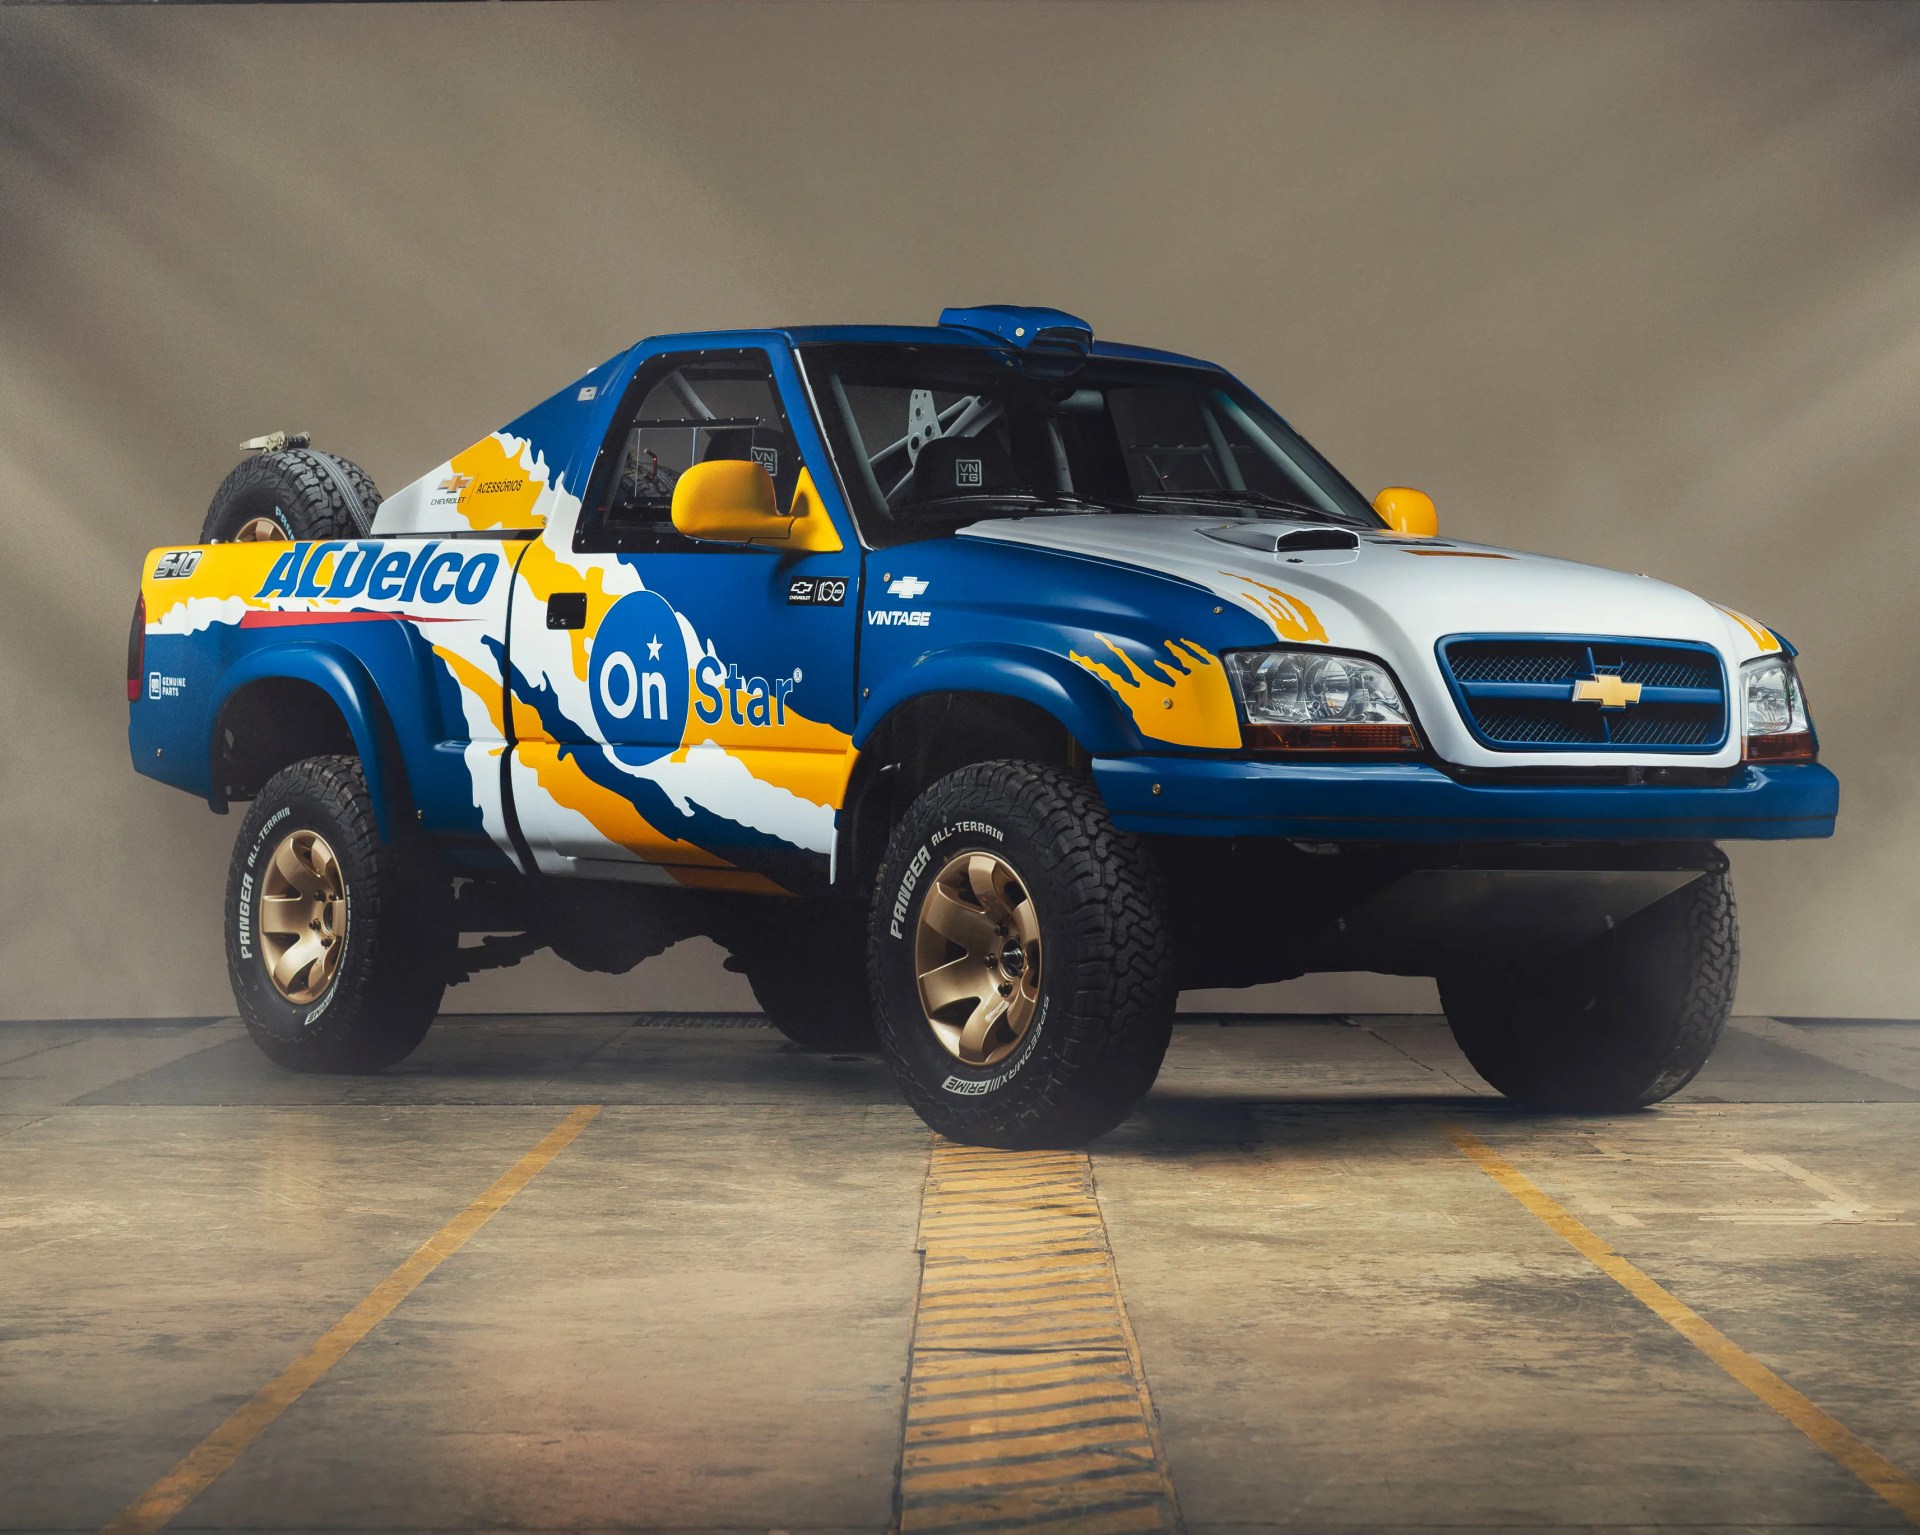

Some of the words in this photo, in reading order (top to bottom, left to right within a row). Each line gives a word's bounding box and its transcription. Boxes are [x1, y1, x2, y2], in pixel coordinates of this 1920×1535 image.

[753, 450, 774, 462] VN
[959, 463, 978, 473] VN
[959, 473, 978, 482] TG
[430, 496, 466, 506] CHEVROLET
[476, 478, 523, 494] ACESSÓRIOS
[153, 551, 203, 578] S-10
[253, 541, 500, 605] ACDelco
[867, 610, 932, 627] VINTAGE
[162, 676, 186, 687] GENUINE
[162, 686, 179, 697] PARTS
[600, 651, 668, 721] On
[239, 872, 253, 960] PANGEA
[247, 806, 291, 868] ALL-TERRAIN
[890, 845, 931, 940] PANGEA
[931, 821, 1004, 847] ALL-TERRAIN
